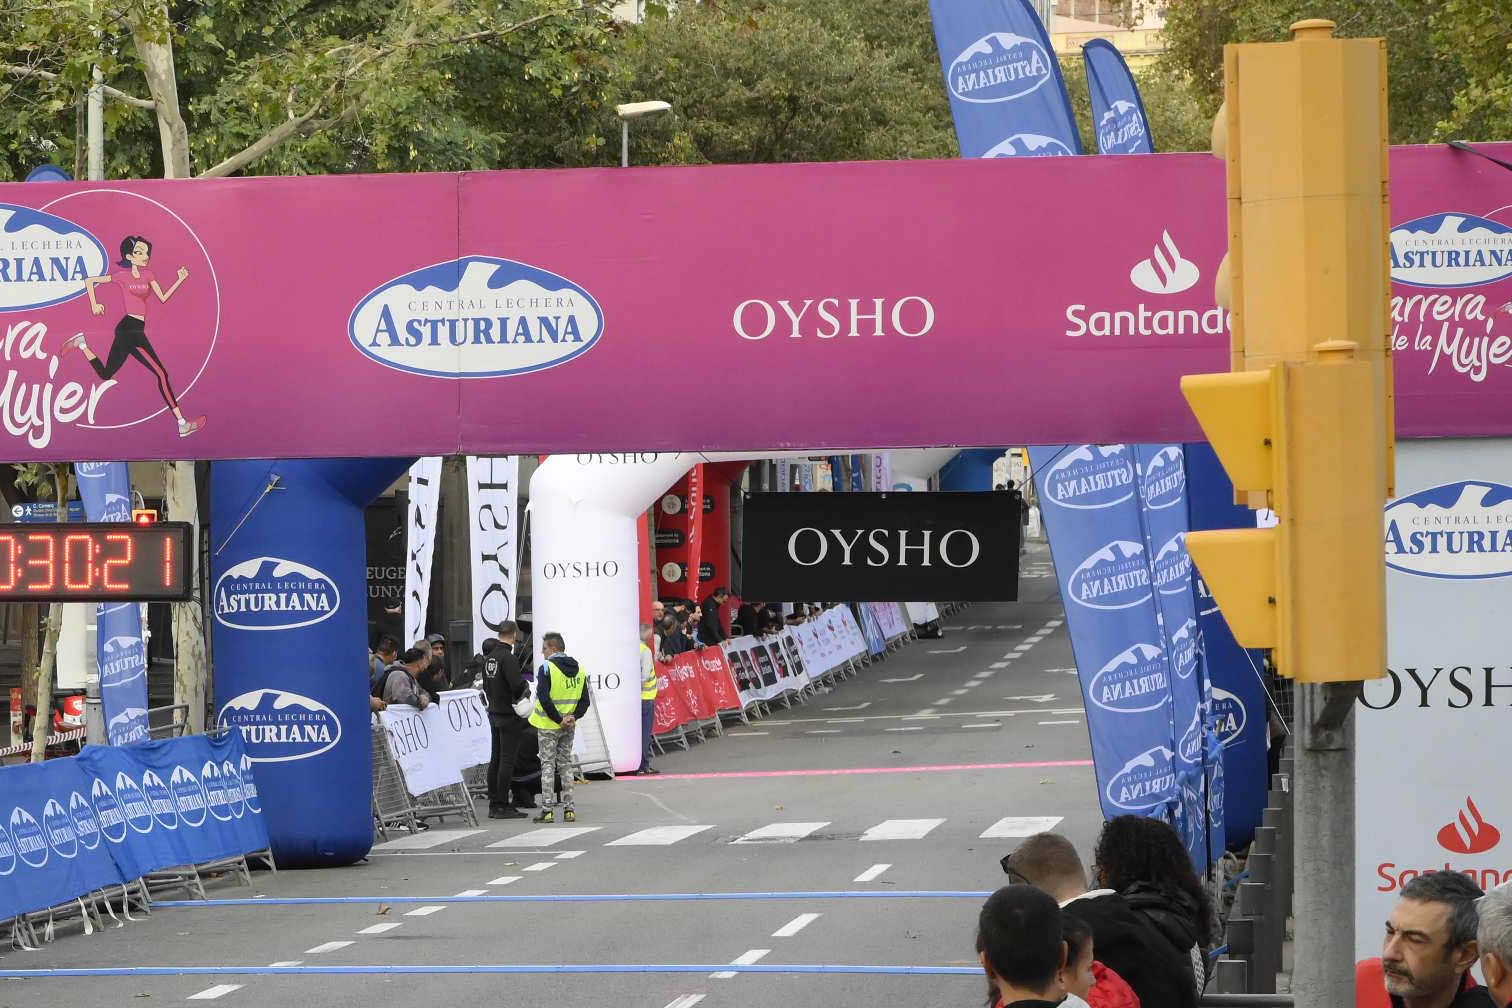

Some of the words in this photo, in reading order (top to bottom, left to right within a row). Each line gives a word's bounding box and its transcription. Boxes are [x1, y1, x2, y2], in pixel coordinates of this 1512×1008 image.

[10, 239, 83, 250] LECHERA
[408, 299, 486, 312] CENTRAL
[495, 297, 575, 309] LECHERA
[732, 296, 936, 340] OYSHO
[1391, 293, 1487, 323] arrera
[368, 303, 583, 348] ASTURIANA
[1066, 303, 1231, 337] Santand
[1415, 323, 1432, 350] la
[1428, 317, 1512, 382] Muje
[1412, 516, 1478, 525] CENTRAL
[479, 457, 510, 632] OYSH
[788, 527, 980, 568] OYSHO
[1384, 518, 1512, 555] ASTURIA
[543, 561, 619, 580] OYSHO
[218, 587, 330, 614] ASTURIANA
[231, 582, 272, 591] CENTRAL
[277, 582, 326, 590] LECHERA
[565, 676, 581, 689] Life
[1357, 667, 1512, 710] OYSH
[232, 714, 273, 722] CENTRAL
[448, 696, 482, 732] OYS
[240, 724, 331, 744] TURIANA
